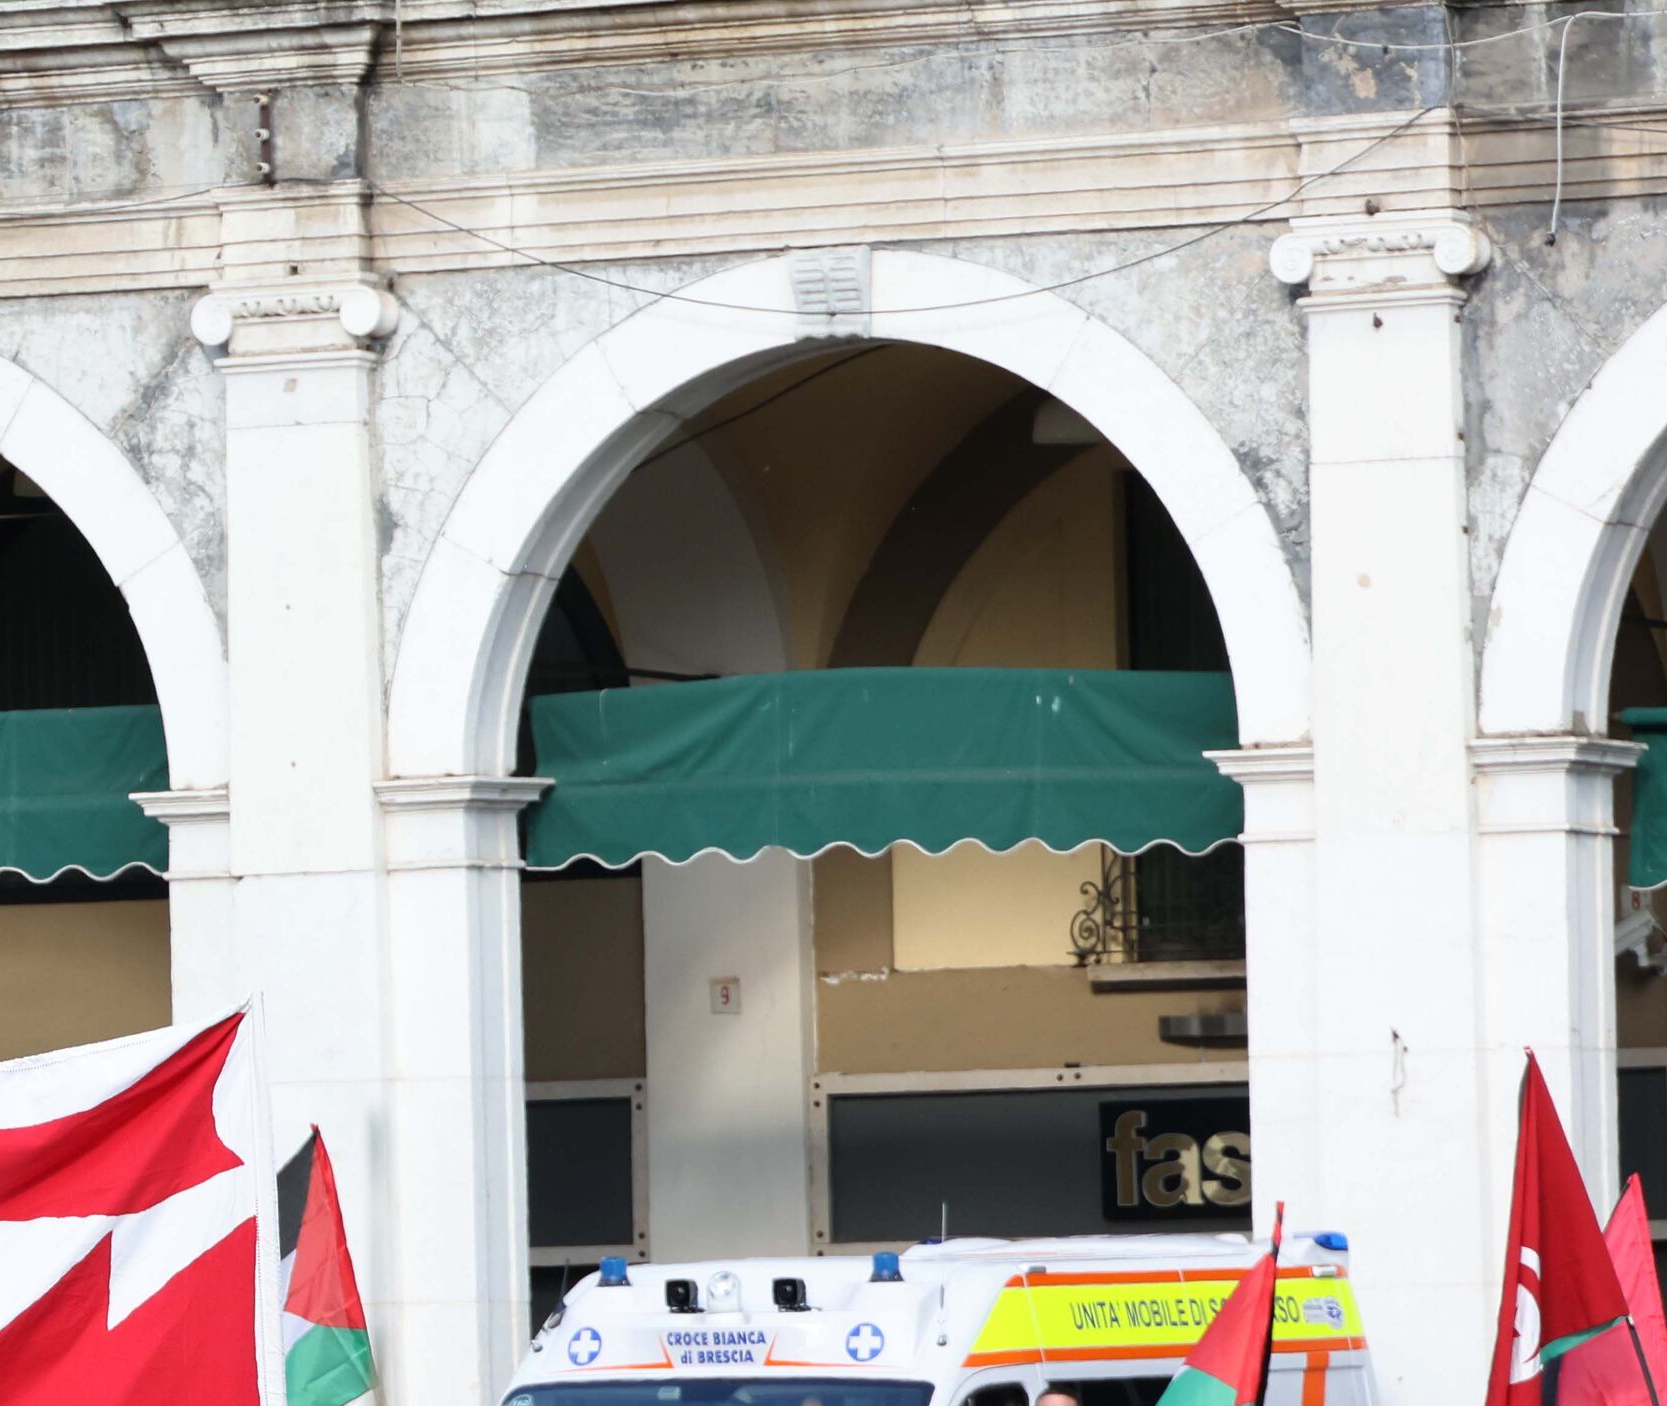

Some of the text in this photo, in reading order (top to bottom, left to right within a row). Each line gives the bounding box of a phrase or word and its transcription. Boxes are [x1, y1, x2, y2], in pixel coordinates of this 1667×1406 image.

[1106, 1109, 1251, 1207] fas
[1069, 1300, 1121, 1330] UNITA'
[1125, 1298, 1189, 1328] MOBILE
[1192, 1300, 1210, 1326] DI
[667, 1331, 766, 1346] CROCE BIANCA
[681, 1350, 754, 1364] di BRESCIA
